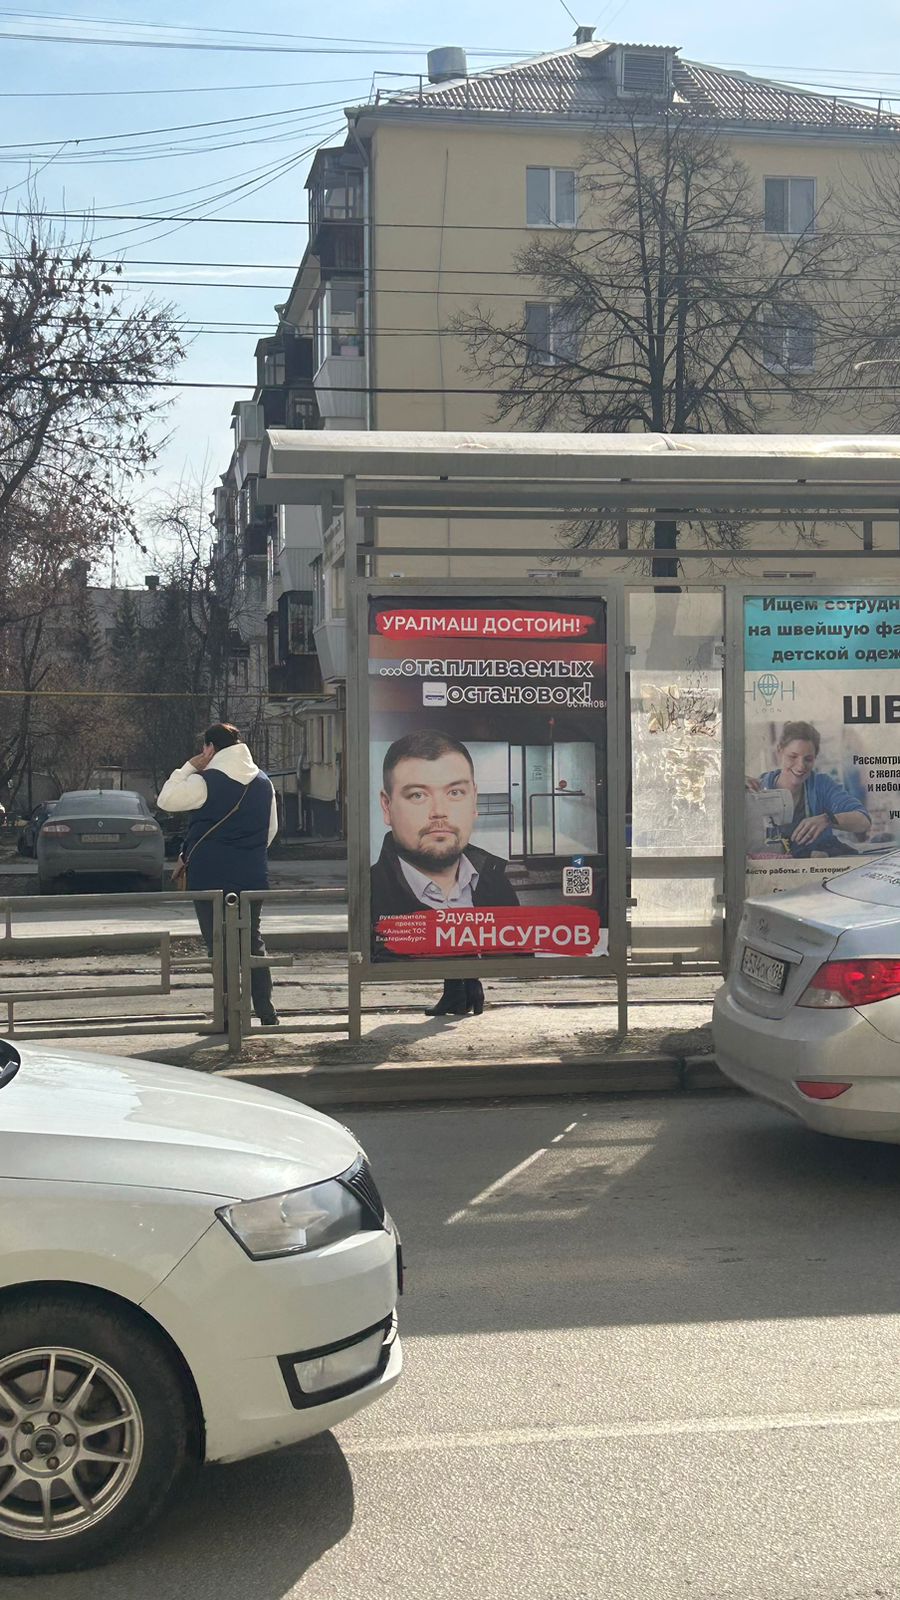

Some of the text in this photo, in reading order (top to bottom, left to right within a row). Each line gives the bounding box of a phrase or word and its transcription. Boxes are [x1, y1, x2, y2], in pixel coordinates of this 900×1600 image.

[762, 598, 818, 613] Ищем
[383, 616, 580, 633] УРАЛМАШ ДОСТОИН!
[748, 625, 771, 636] на
[777, 621, 870, 639] швейшую
[772, 646, 849, 663] детской
[380, 659, 594, 677] ...отапливаемых
[446, 682, 592, 704] остановок!
[869, 769, 875, 778] с
[868, 783, 873, 792] и
[436, 910, 495, 924] Эдуард
[435, 924, 592, 947] МАНСУРОВ
